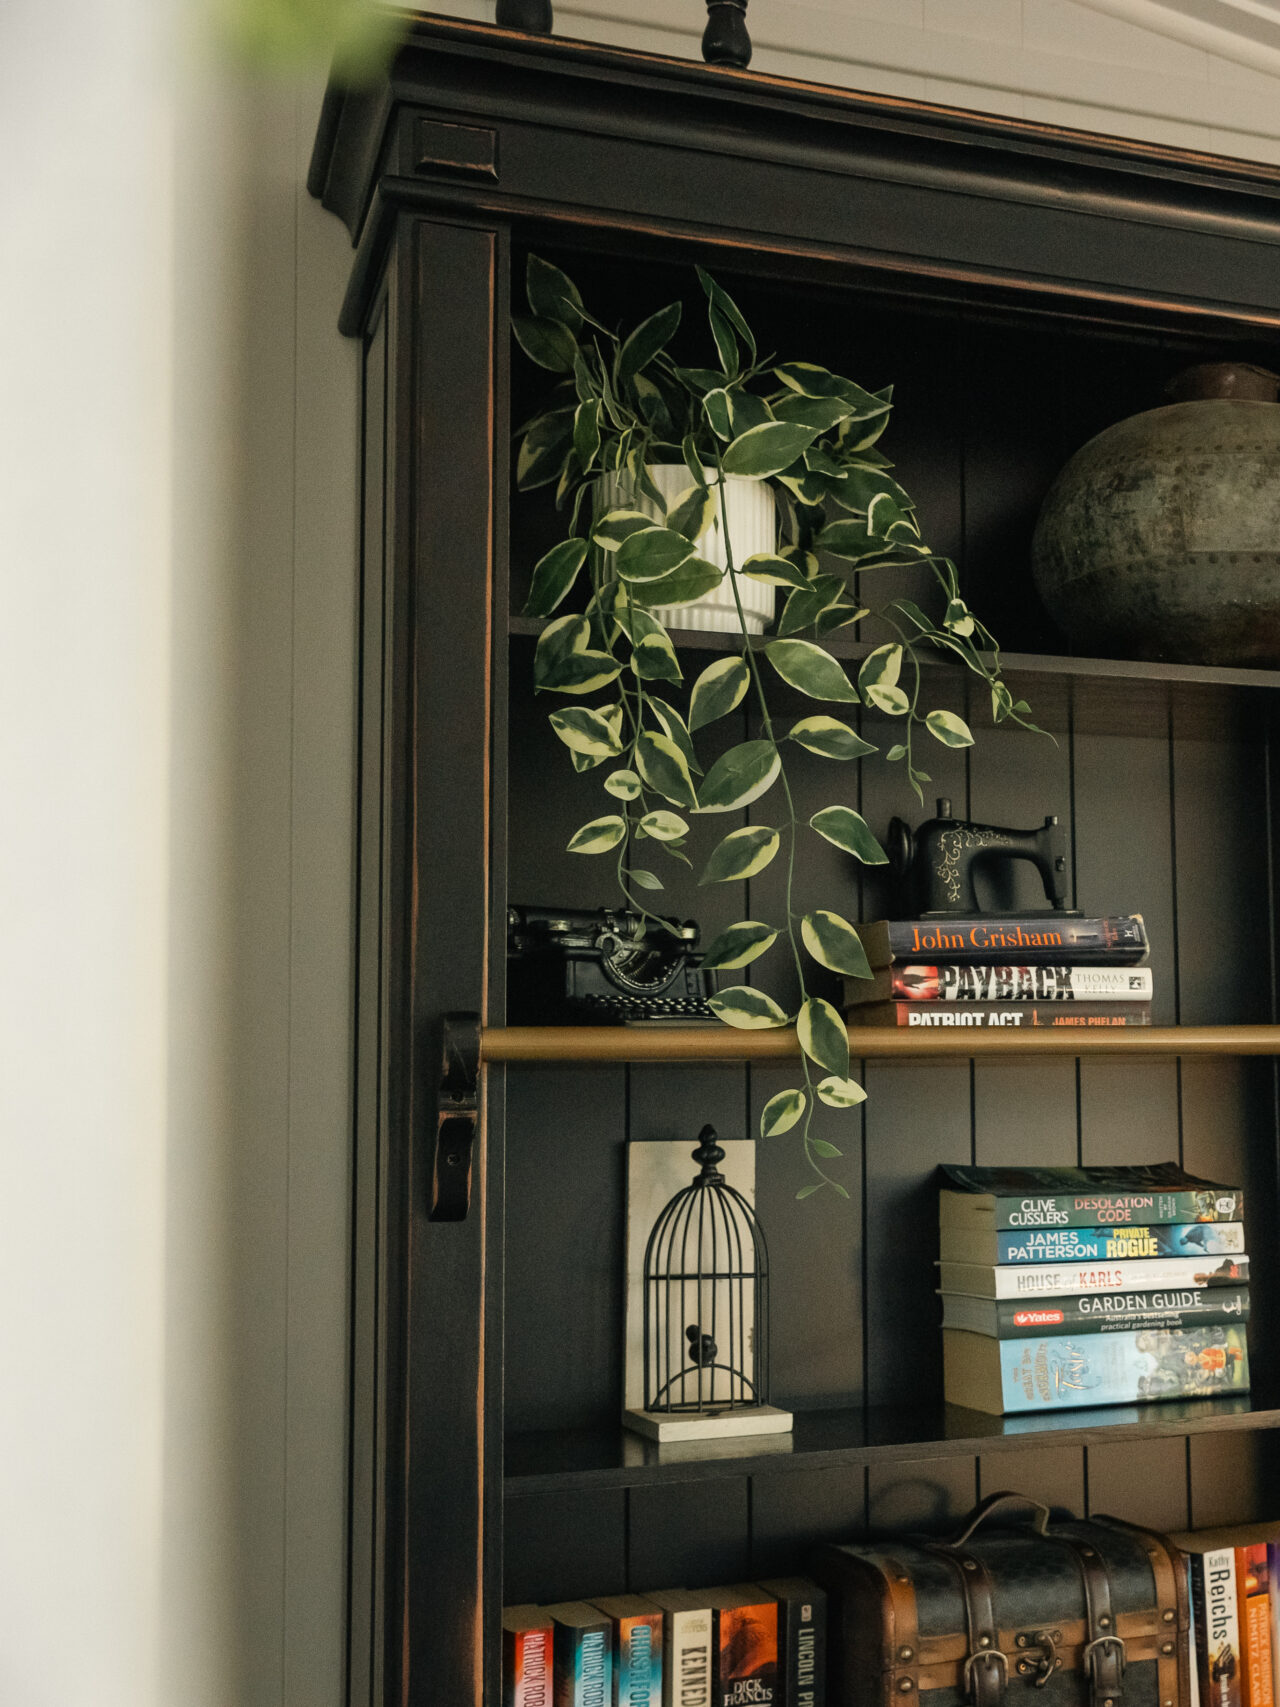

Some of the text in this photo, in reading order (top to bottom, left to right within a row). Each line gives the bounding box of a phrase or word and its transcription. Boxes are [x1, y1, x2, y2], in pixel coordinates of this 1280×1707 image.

[911, 924, 1062, 952] John Grisham
[938, 965, 1075, 1000] PAYBACK
[1075, 973, 1126, 983] THOMAS
[1084, 984, 1119, 994] KELLY
[908, 1012, 1024, 1026] PATRIOT ACT
[1051, 1017, 1126, 1026] JAMES PHELAN
[1021, 1199, 1056, 1212] CLIVE
[1074, 1196, 1153, 1210] DESOLATION
[1009, 1210, 1069, 1225] CUSSLER'S
[1097, 1209, 1132, 1222] CODE
[1026, 1232, 1079, 1246] JAMES
[1113, 1227, 1150, 1239] PRIVATE
[1008, 1244, 1098, 1260] PATTERSON
[1106, 1238, 1158, 1258] ROGUE
[1017, 1273, 1061, 1292] HOUSE
[1078, 1291, 1203, 1314] GARDEN GUIDE
[1027, 1312, 1061, 1323] Yates
[1100, 1318, 1182, 1332] practical gardening book
[1208, 1554, 1230, 1568] Kathy
[1210, 1569, 1233, 1640] Reichs
[523, 1633, 546, 1684] PATRICK
[582, 1631, 604, 1681] PATRICK
[629, 1624, 652, 1678] GHOST
[798, 1628, 815, 1685] LINCOLN
[1249, 1607, 1261, 1706] NIMITZ CLASS
[1259, 1602, 1272, 1705] PATRICK ROBINSON
[681, 1646, 707, 1707] KENNED
[734, 1678, 763, 1694] DICK
[723, 1688, 773, 1706] FRANCIS
